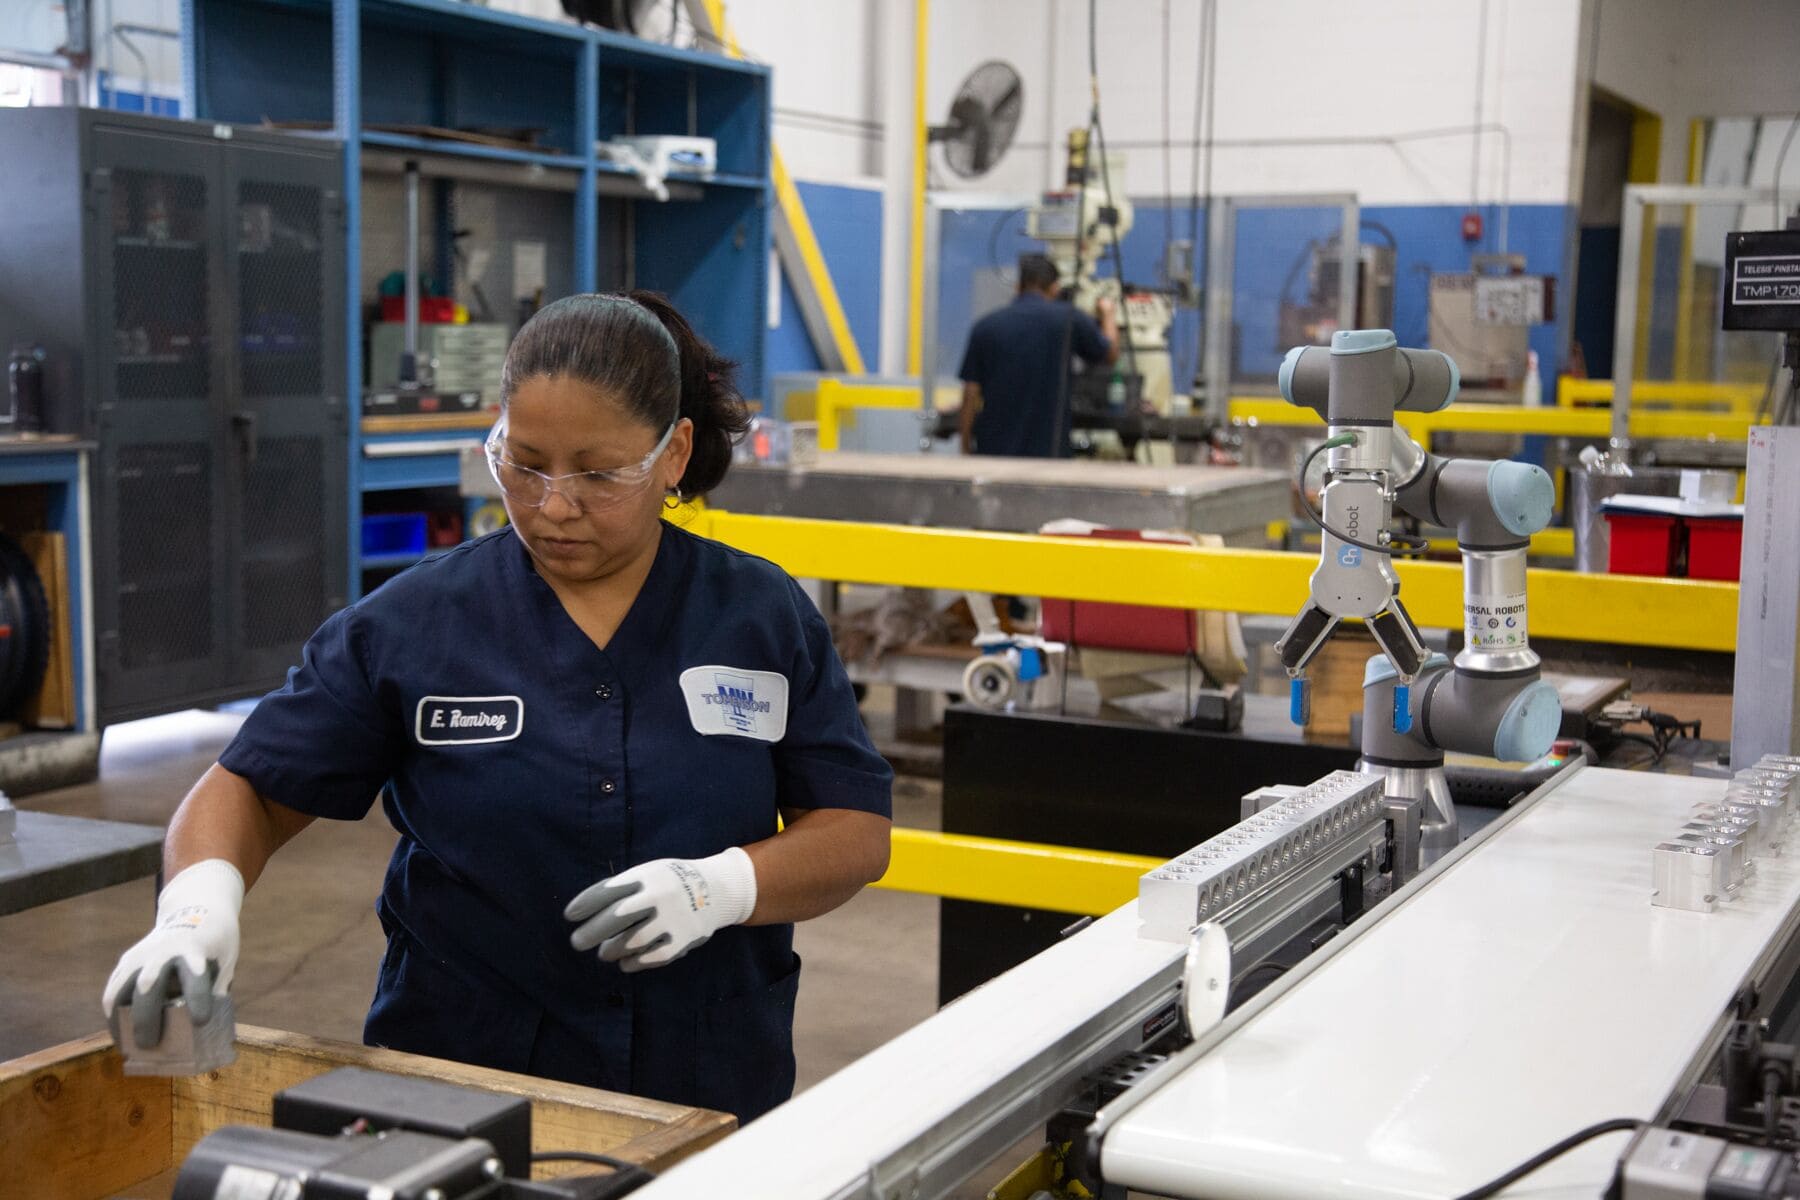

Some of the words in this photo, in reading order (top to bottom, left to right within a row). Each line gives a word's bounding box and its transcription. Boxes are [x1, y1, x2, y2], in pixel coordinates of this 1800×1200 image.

[1774, 264, 1800, 273] PINSTA
[1743, 285, 1800, 297] TMP170
[1495, 604, 1525, 615] ROBOTS
[430, 709, 446, 728] E.
[450, 709, 508, 732] Ramirez
